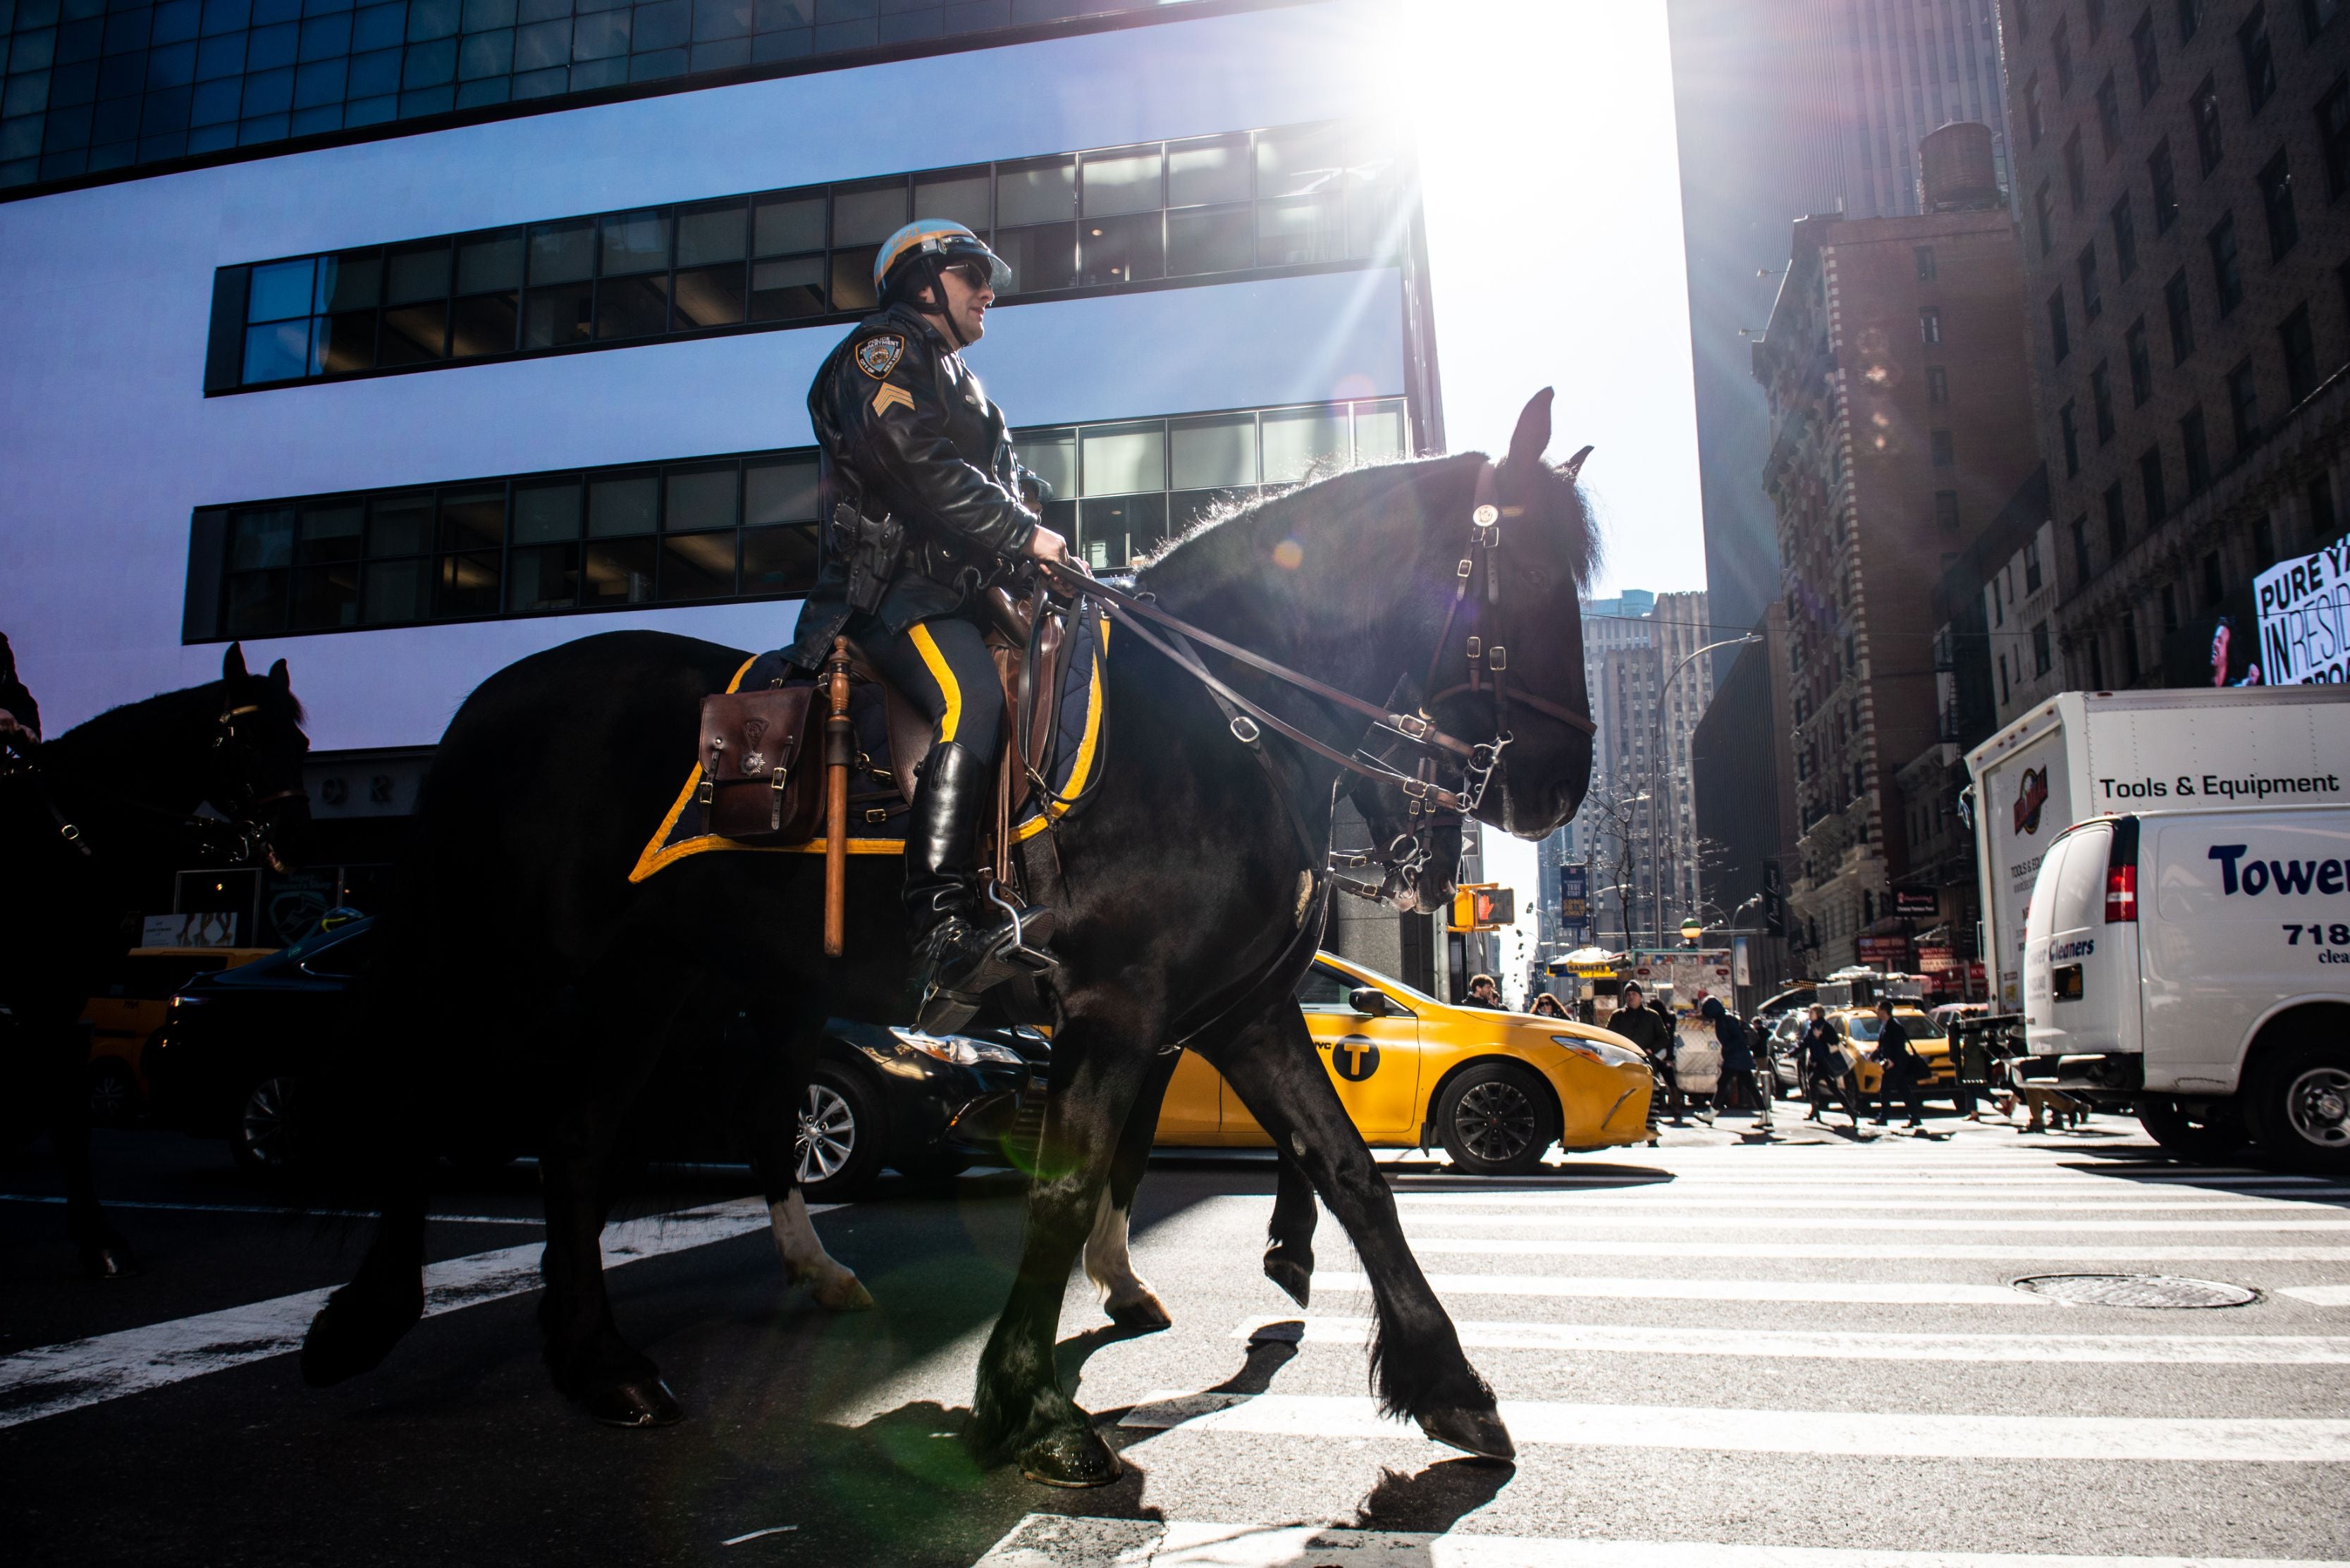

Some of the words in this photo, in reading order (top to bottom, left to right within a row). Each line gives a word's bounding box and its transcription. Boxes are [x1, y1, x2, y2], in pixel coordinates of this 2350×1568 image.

[860, 340, 899, 354] DEPARTMENT
[868, 336, 890, 345] POLICE
[860, 358, 868, 369] CITY
[883, 361, 893, 373] NEW
[890, 348, 901, 362] YORK
[2260, 552, 2330, 620] PURE
[2100, 777, 2167, 798] Tools
[2177, 776, 2196, 796] &
[2203, 774, 2339, 799] Equipment
[2010, 861, 2026, 879] TOOLS
[2282, 924, 2350, 945] 718
[2049, 939, 2094, 962] Cleaners
[1344, 1043, 1370, 1075] T
